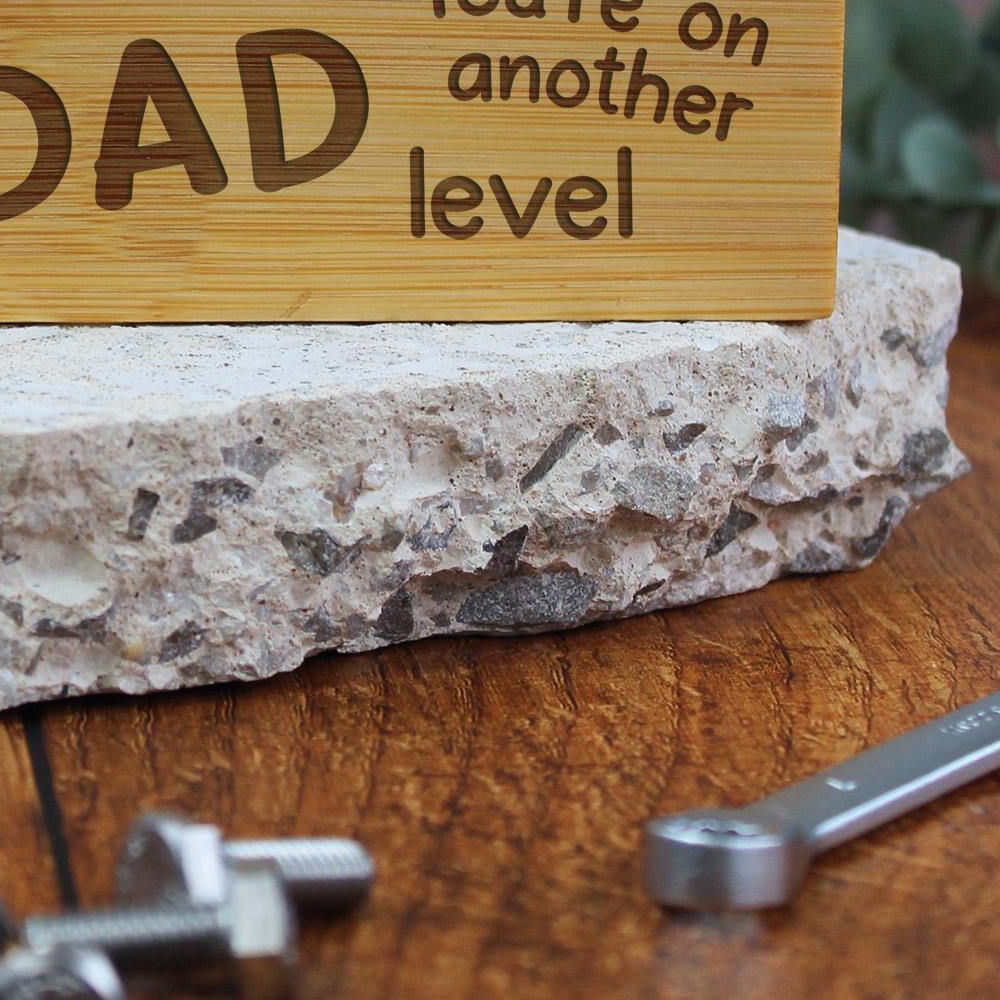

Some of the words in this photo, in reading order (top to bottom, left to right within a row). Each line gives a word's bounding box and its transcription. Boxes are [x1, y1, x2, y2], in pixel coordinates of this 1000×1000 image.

[677, 1, 770, 68] on
[447, 46, 754, 142] another
[409, 145, 633, 240] level
